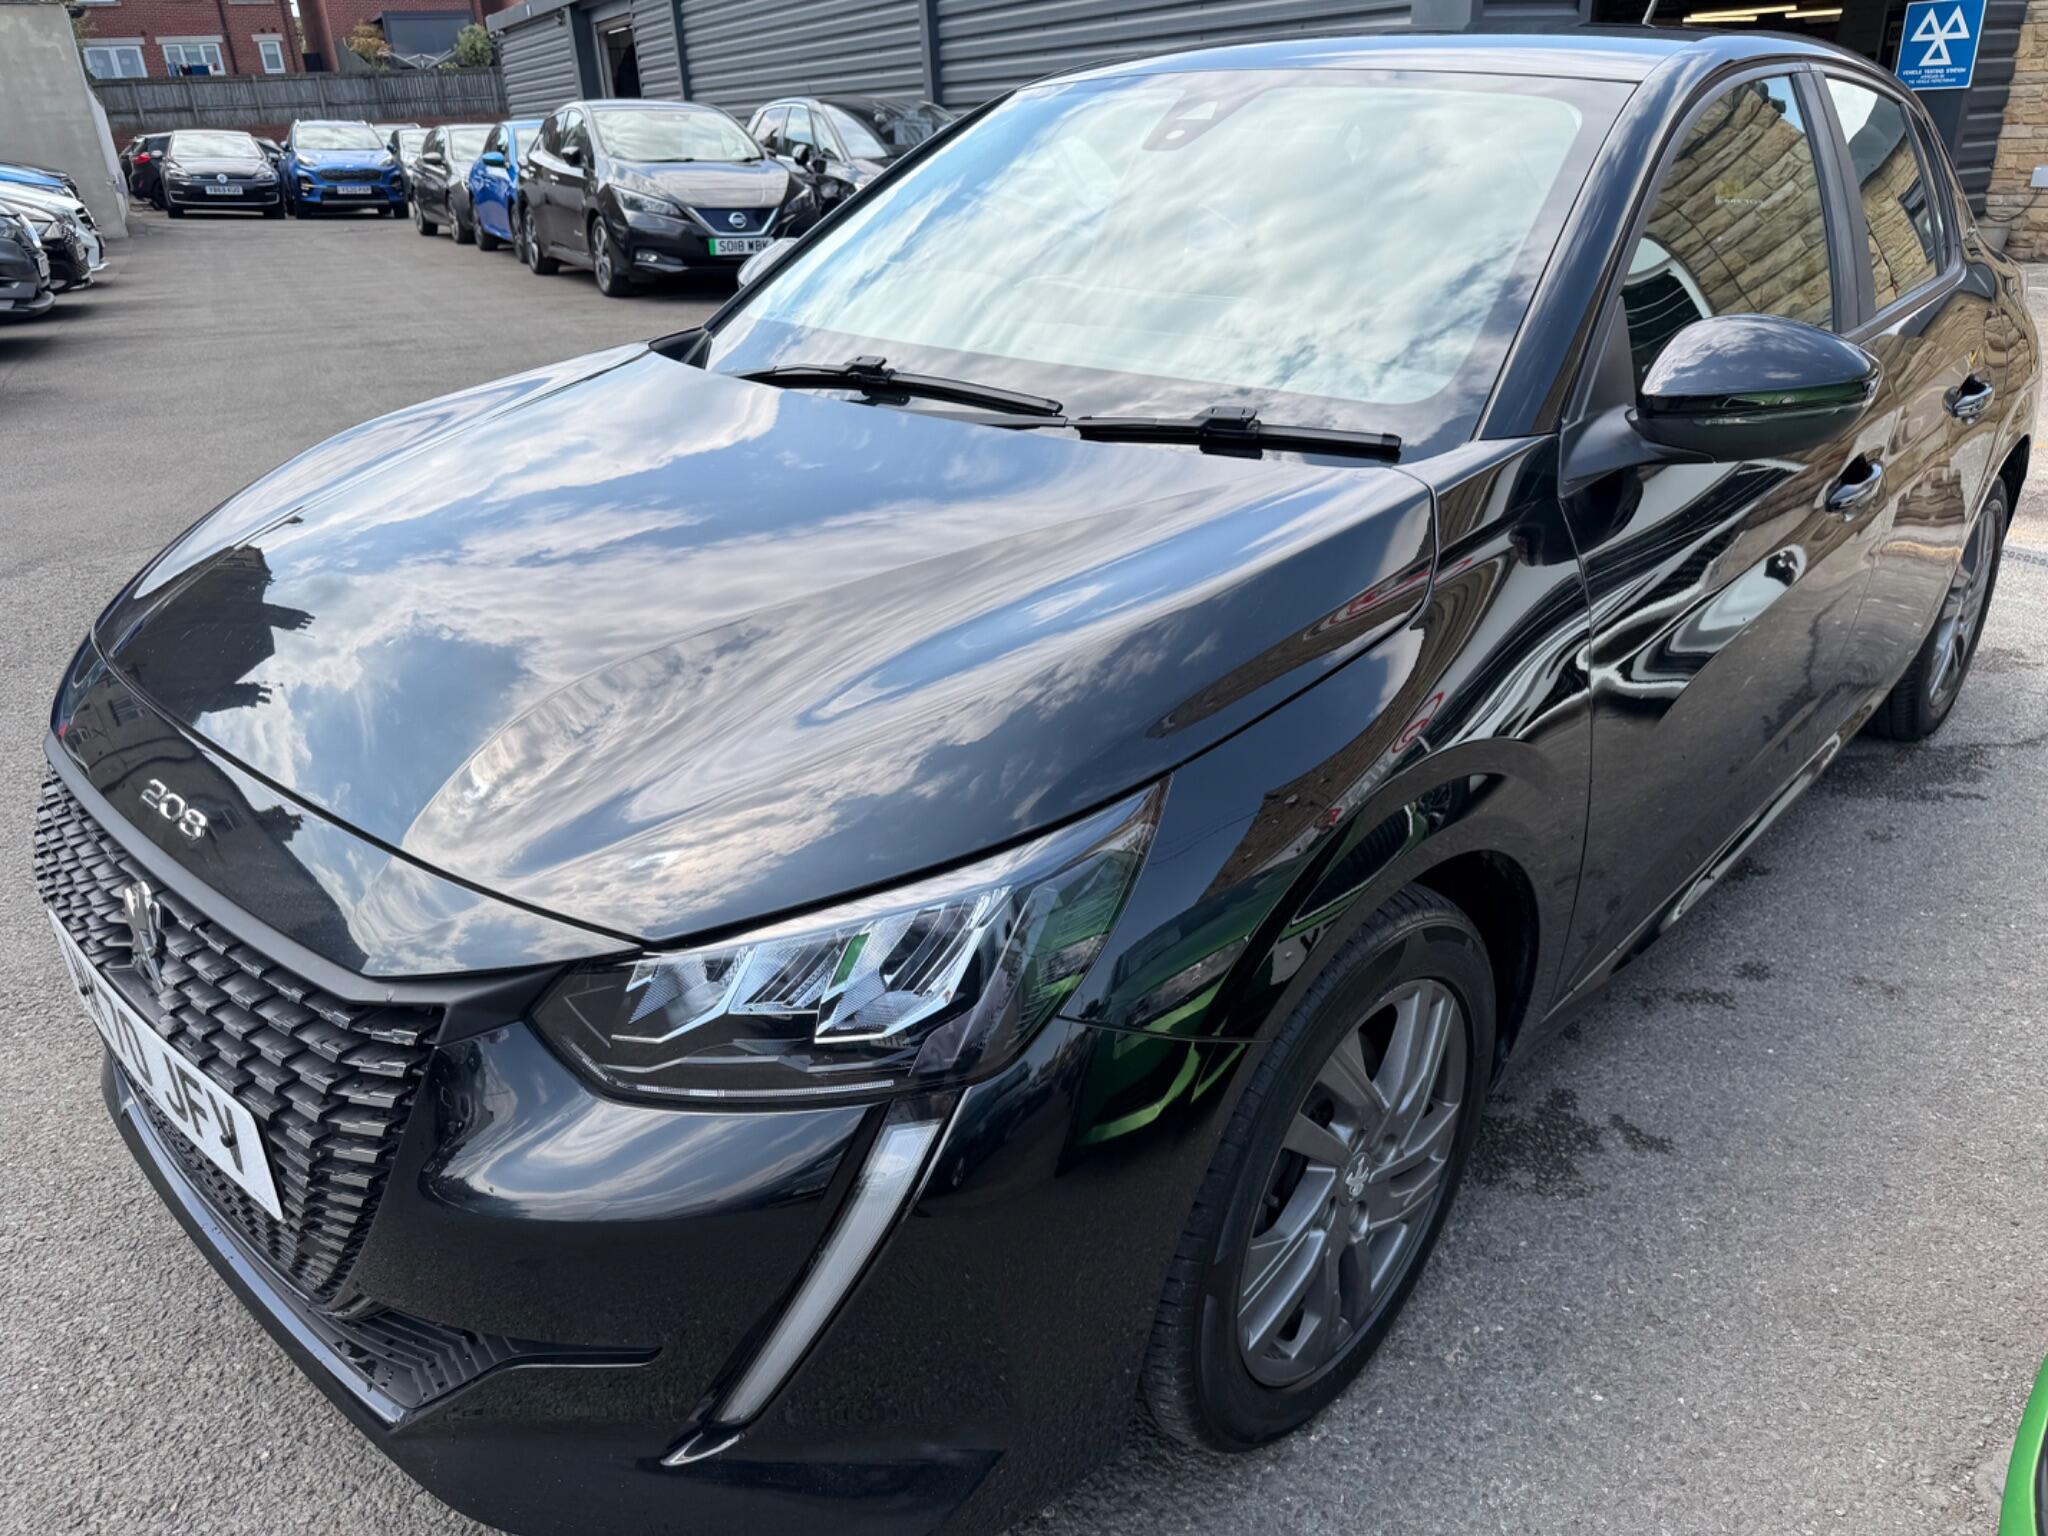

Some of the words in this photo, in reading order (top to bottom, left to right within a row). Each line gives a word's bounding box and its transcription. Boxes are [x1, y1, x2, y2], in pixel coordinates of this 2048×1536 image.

[719, 240, 745, 252] SO18
[141, 779, 208, 839] 208
[163, 1051, 245, 1176] JFV
